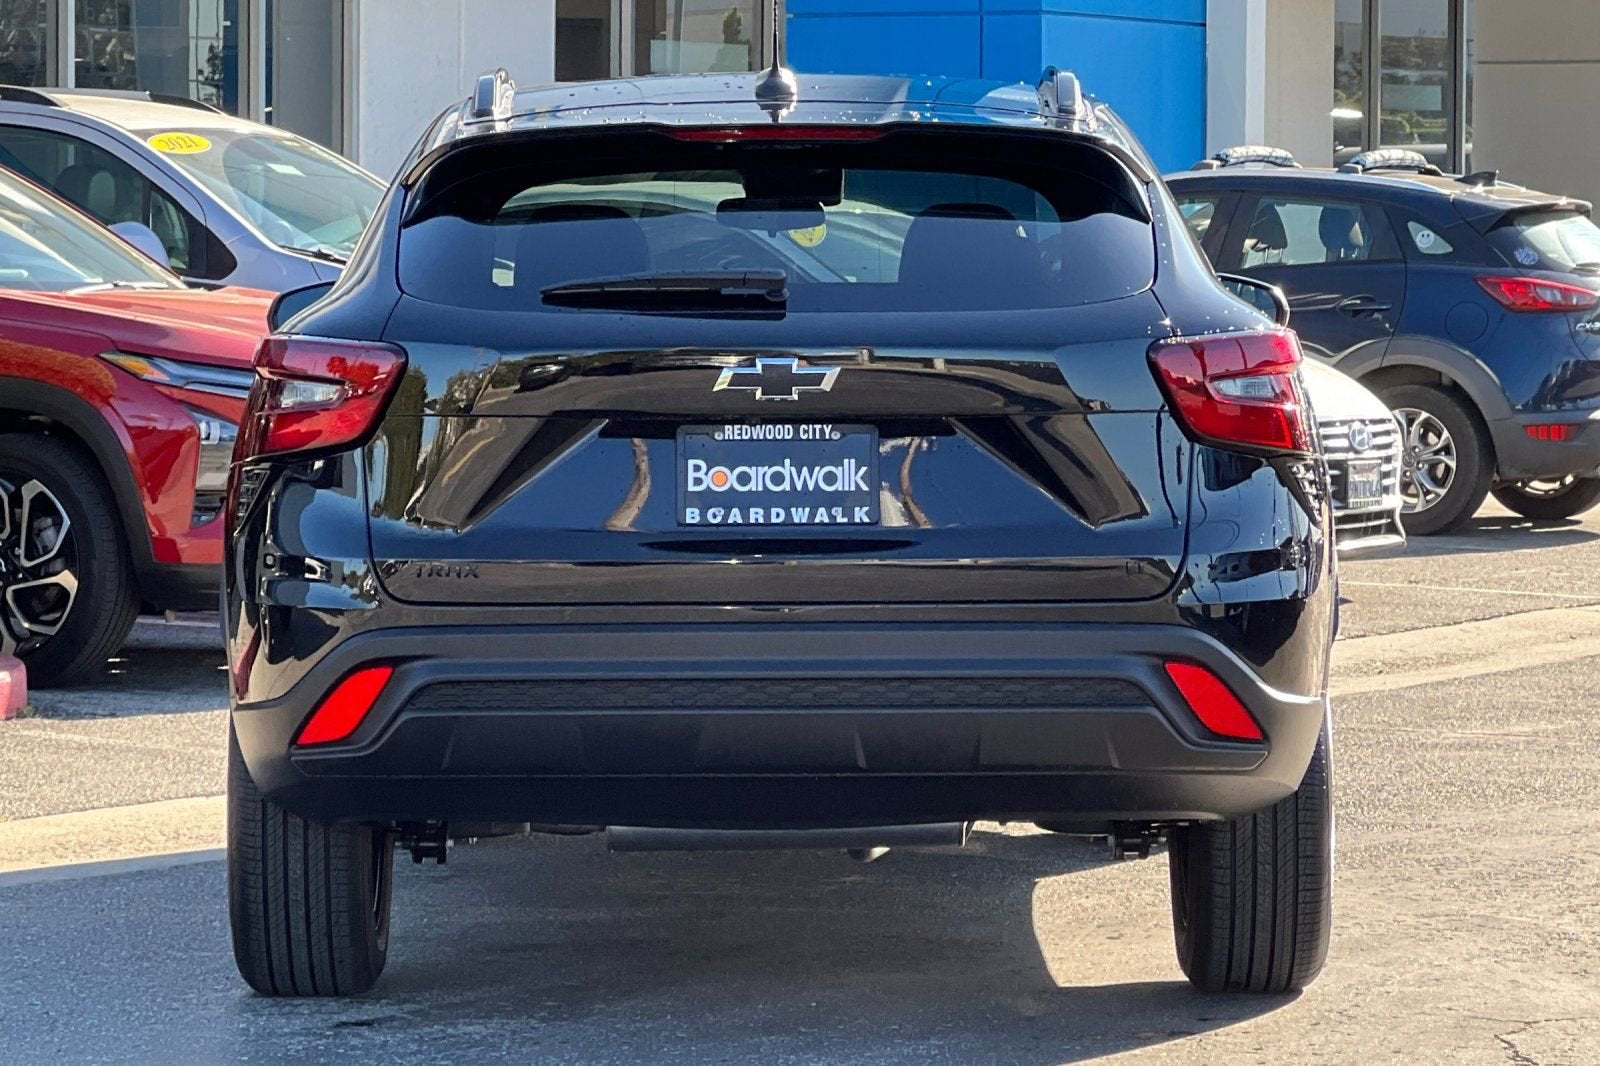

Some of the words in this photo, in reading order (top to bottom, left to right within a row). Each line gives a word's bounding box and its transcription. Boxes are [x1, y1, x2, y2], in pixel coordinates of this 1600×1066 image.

[724, 424, 794, 440] REDWOOD
[799, 424, 833, 440] CITY
[687, 458, 870, 492] Boardwalk
[685, 507, 871, 524] BOARDWALK
